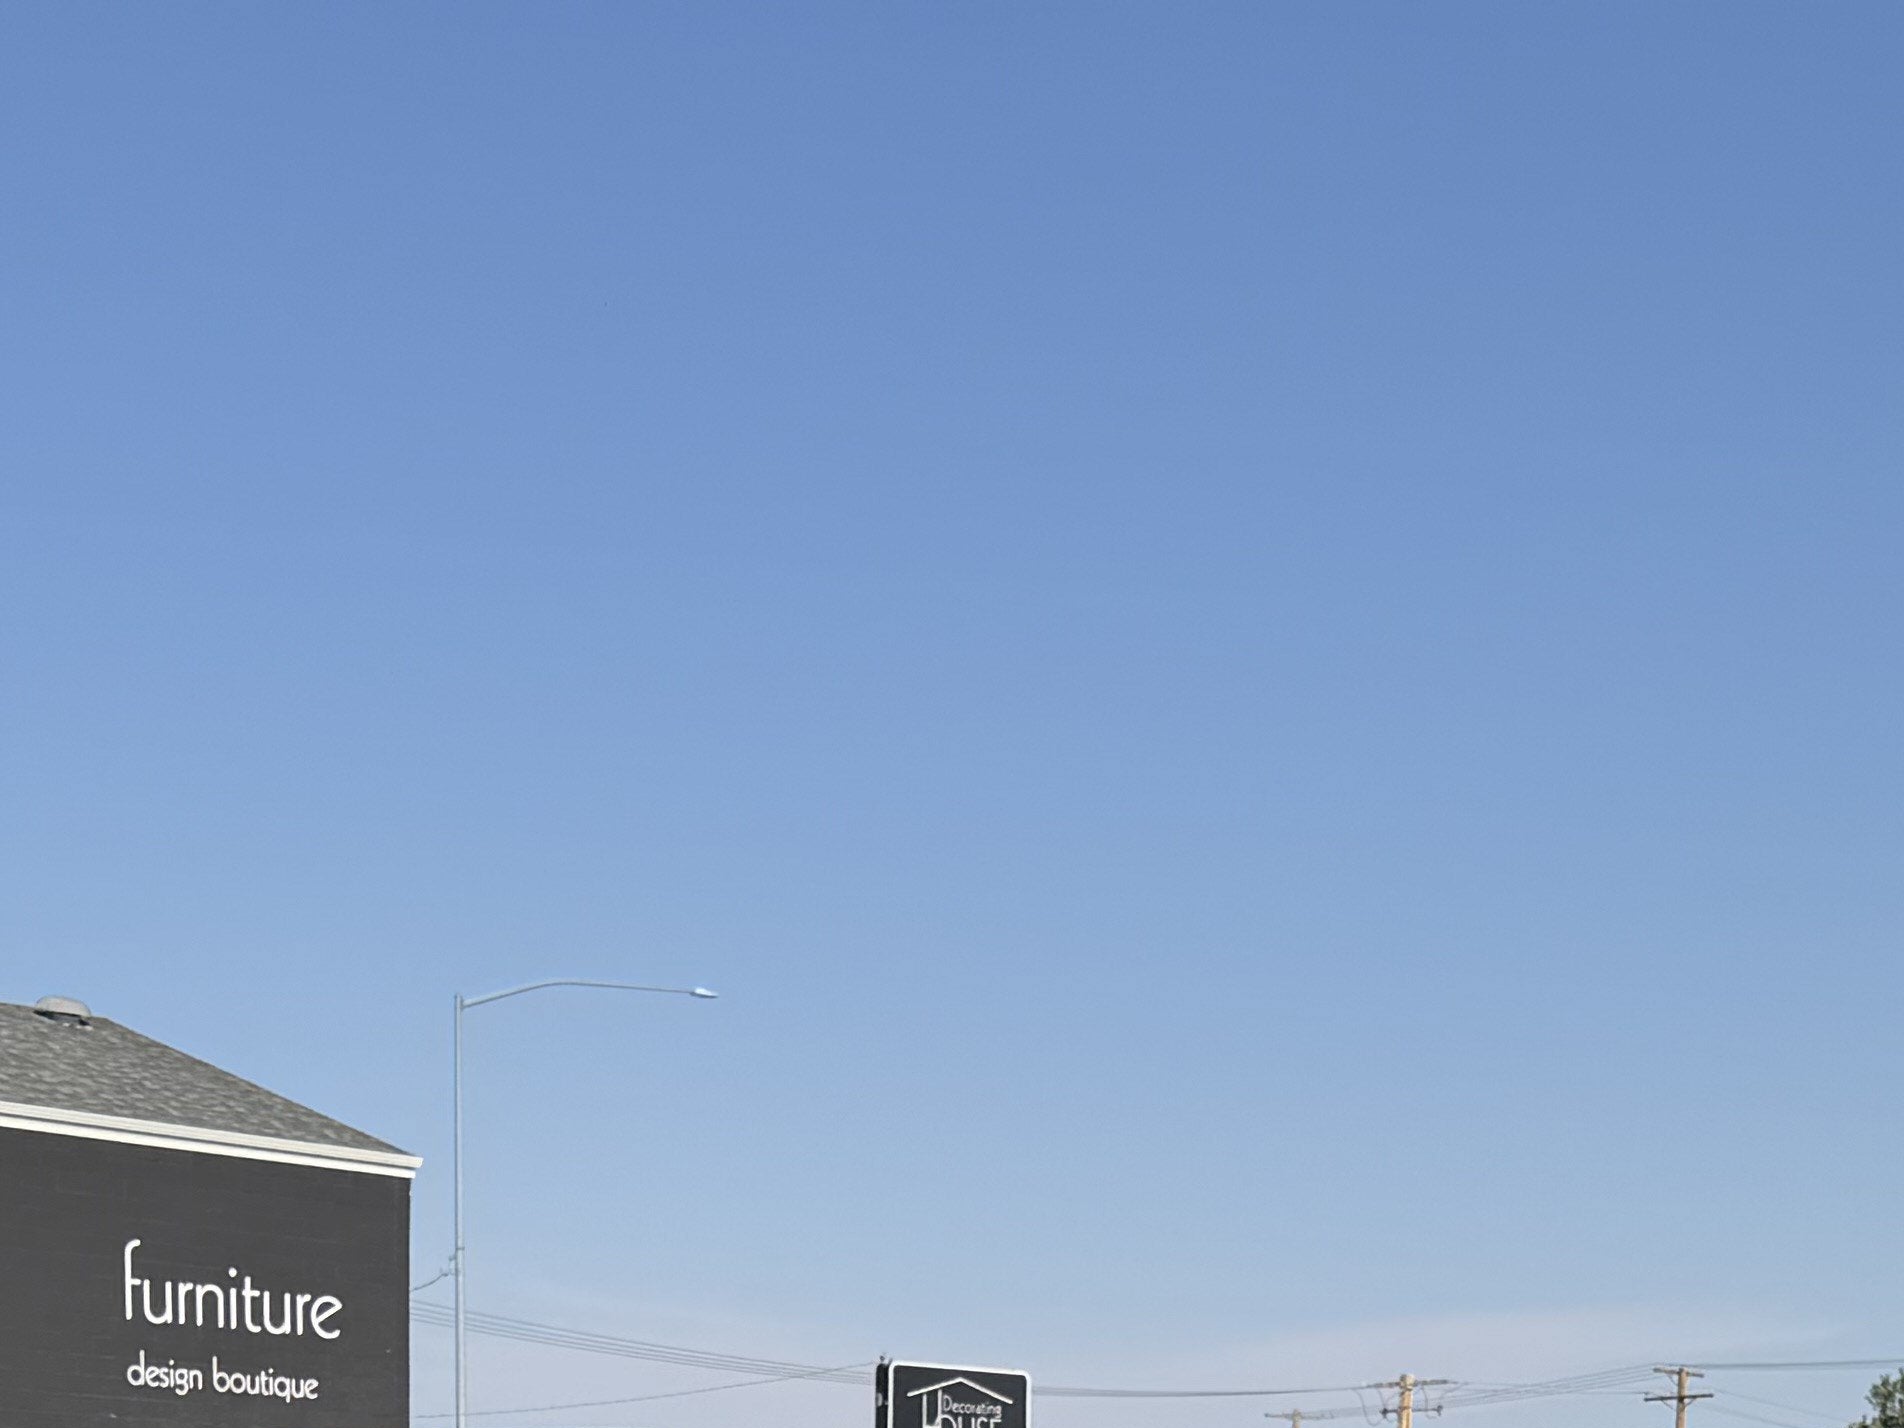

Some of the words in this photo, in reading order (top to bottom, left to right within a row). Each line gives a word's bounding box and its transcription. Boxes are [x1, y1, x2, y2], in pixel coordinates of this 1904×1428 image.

[124, 1238, 344, 1340] furniture
[126, 1350, 203, 1396] design
[211, 1355, 320, 1403] boutique
[942, 1395, 1003, 1419] Decorating
